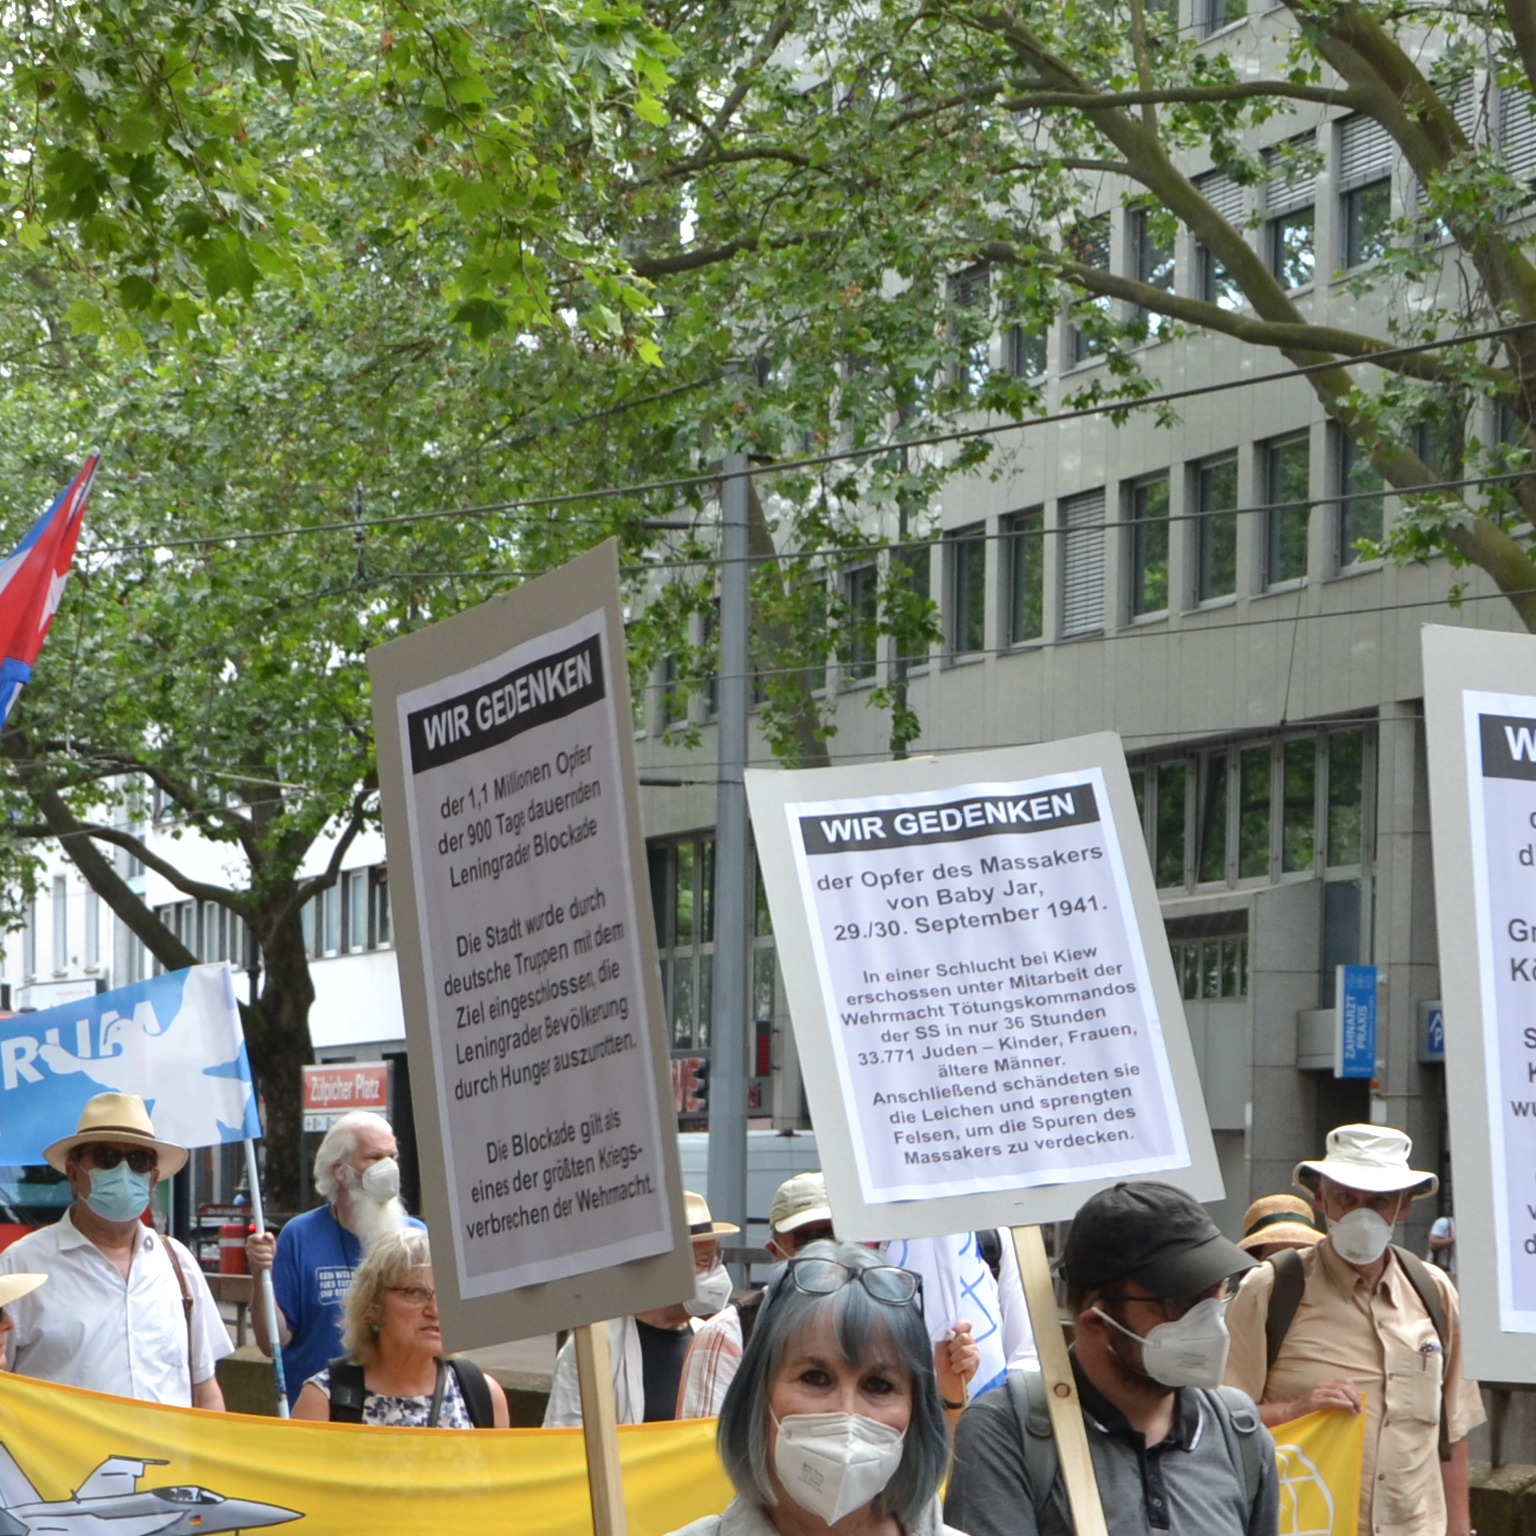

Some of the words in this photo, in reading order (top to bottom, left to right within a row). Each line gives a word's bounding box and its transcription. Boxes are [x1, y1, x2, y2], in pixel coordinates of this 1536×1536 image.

[423, 705, 471, 750] WIR
[477, 651, 592, 729] GEDENKEN
[820, 817, 886, 842] WIR
[894, 793, 1076, 837] GEDENKEN
[817, 874, 854, 891] der
[861, 867, 924, 891] Opfer
[932, 863, 973, 881] des
[979, 846, 1103, 875] Massakers
[886, 895, 930, 911] von
[936, 886, 995, 906] Baby
[1002, 879, 1044, 897] Jar,
[833, 920, 908, 941] 29./30.
[914, 906, 1039, 935] September
[1047, 895, 1107, 918] 1941.
[846, 986, 952, 1006] erschossen
[957, 980, 1004, 995] unter
[1009, 966, 1089, 989] Mitarbeit
[1093, 963, 1123, 977] der
[862, 970, 880, 984] In
[885, 968, 930, 982] einer
[935, 956, 1017, 977] Schlucht
[1020, 951, 1048, 968] bei
[1053, 947, 1097, 963] Kiew
[840, 1005, 945, 1026] Wehrmacht
[948, 982, 1137, 1016] Tötungskommandos
[880, 1029, 910, 1043] der
[915, 1024, 940, 1040] SS
[946, 1023, 963, 1036] in
[968, 1021, 998, 1035] nur
[1003, 1016, 1025, 1030] 36
[1030, 1007, 1106, 1028] Stunden
[1345, 995, 1357, 1059] ZAHNARZT
[1356, 1005, 1369, 1049] PRAXIS
[310, 1075, 354, 1107] Zülpicher
[356, 1073, 380, 1099] Platz
